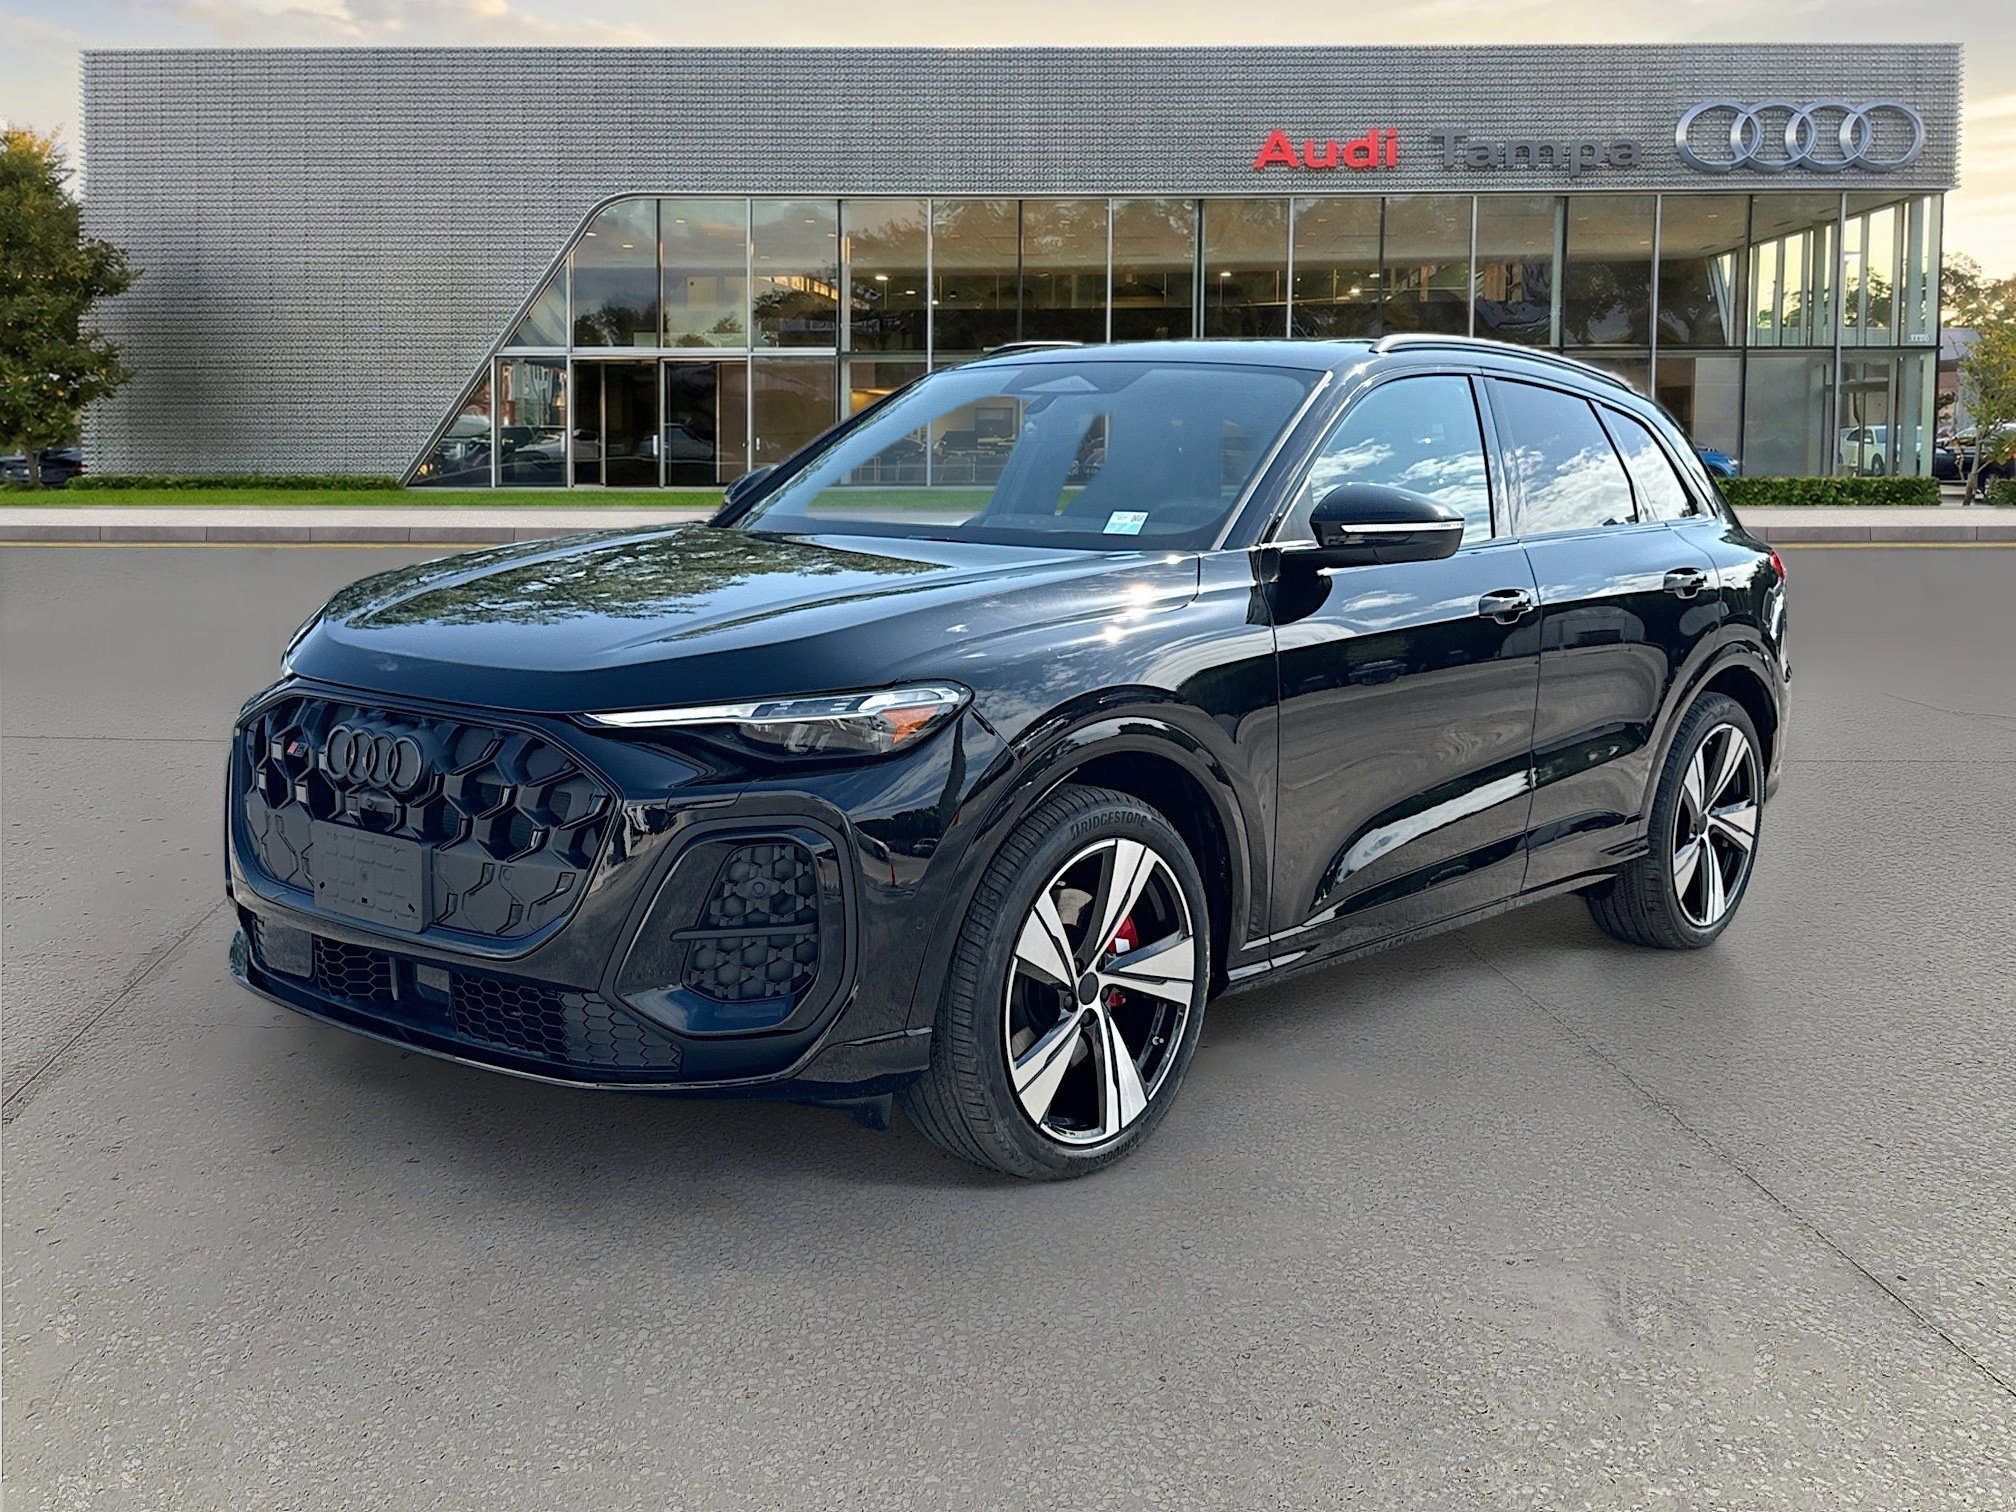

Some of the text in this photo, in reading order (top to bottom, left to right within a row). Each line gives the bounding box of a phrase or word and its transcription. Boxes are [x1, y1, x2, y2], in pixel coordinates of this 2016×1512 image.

[1254, 128, 1642, 177] Audi Tampa
[1070, 811, 1148, 840] BRIDGESTONE
